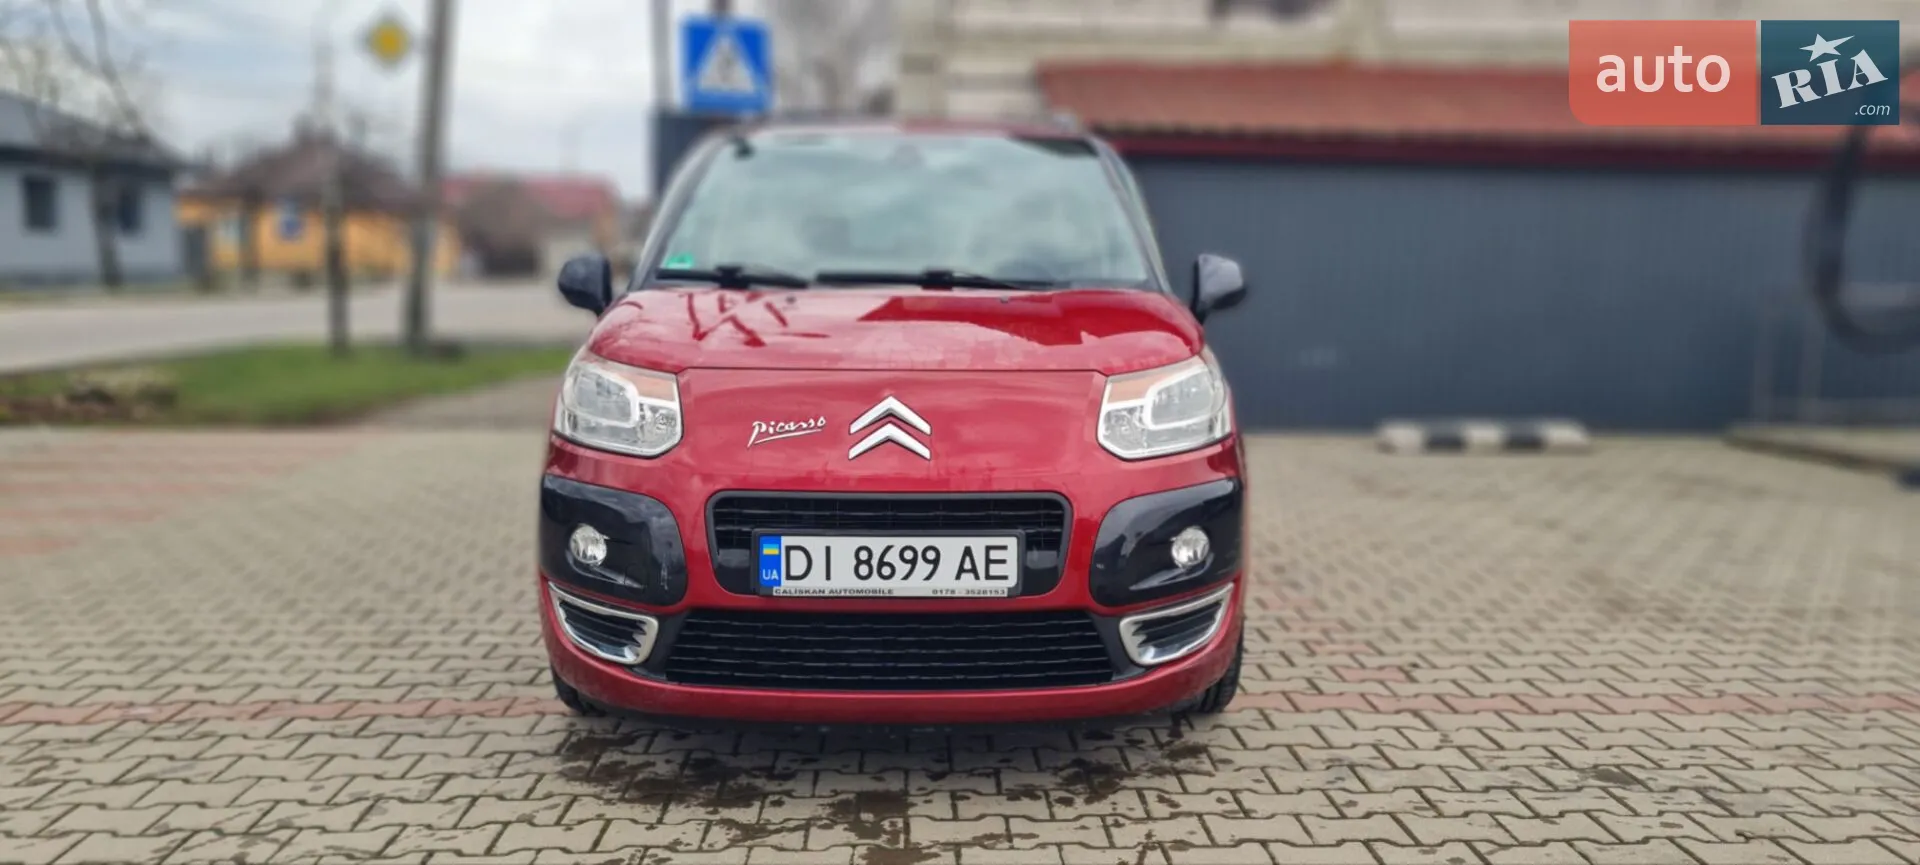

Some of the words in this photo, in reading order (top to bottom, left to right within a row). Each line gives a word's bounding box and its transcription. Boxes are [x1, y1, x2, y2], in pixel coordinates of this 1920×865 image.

[762, 568, 779, 581] UA
[785, 545, 831, 581] DI
[854, 545, 941, 581] 8699
[955, 545, 1009, 581] AE
